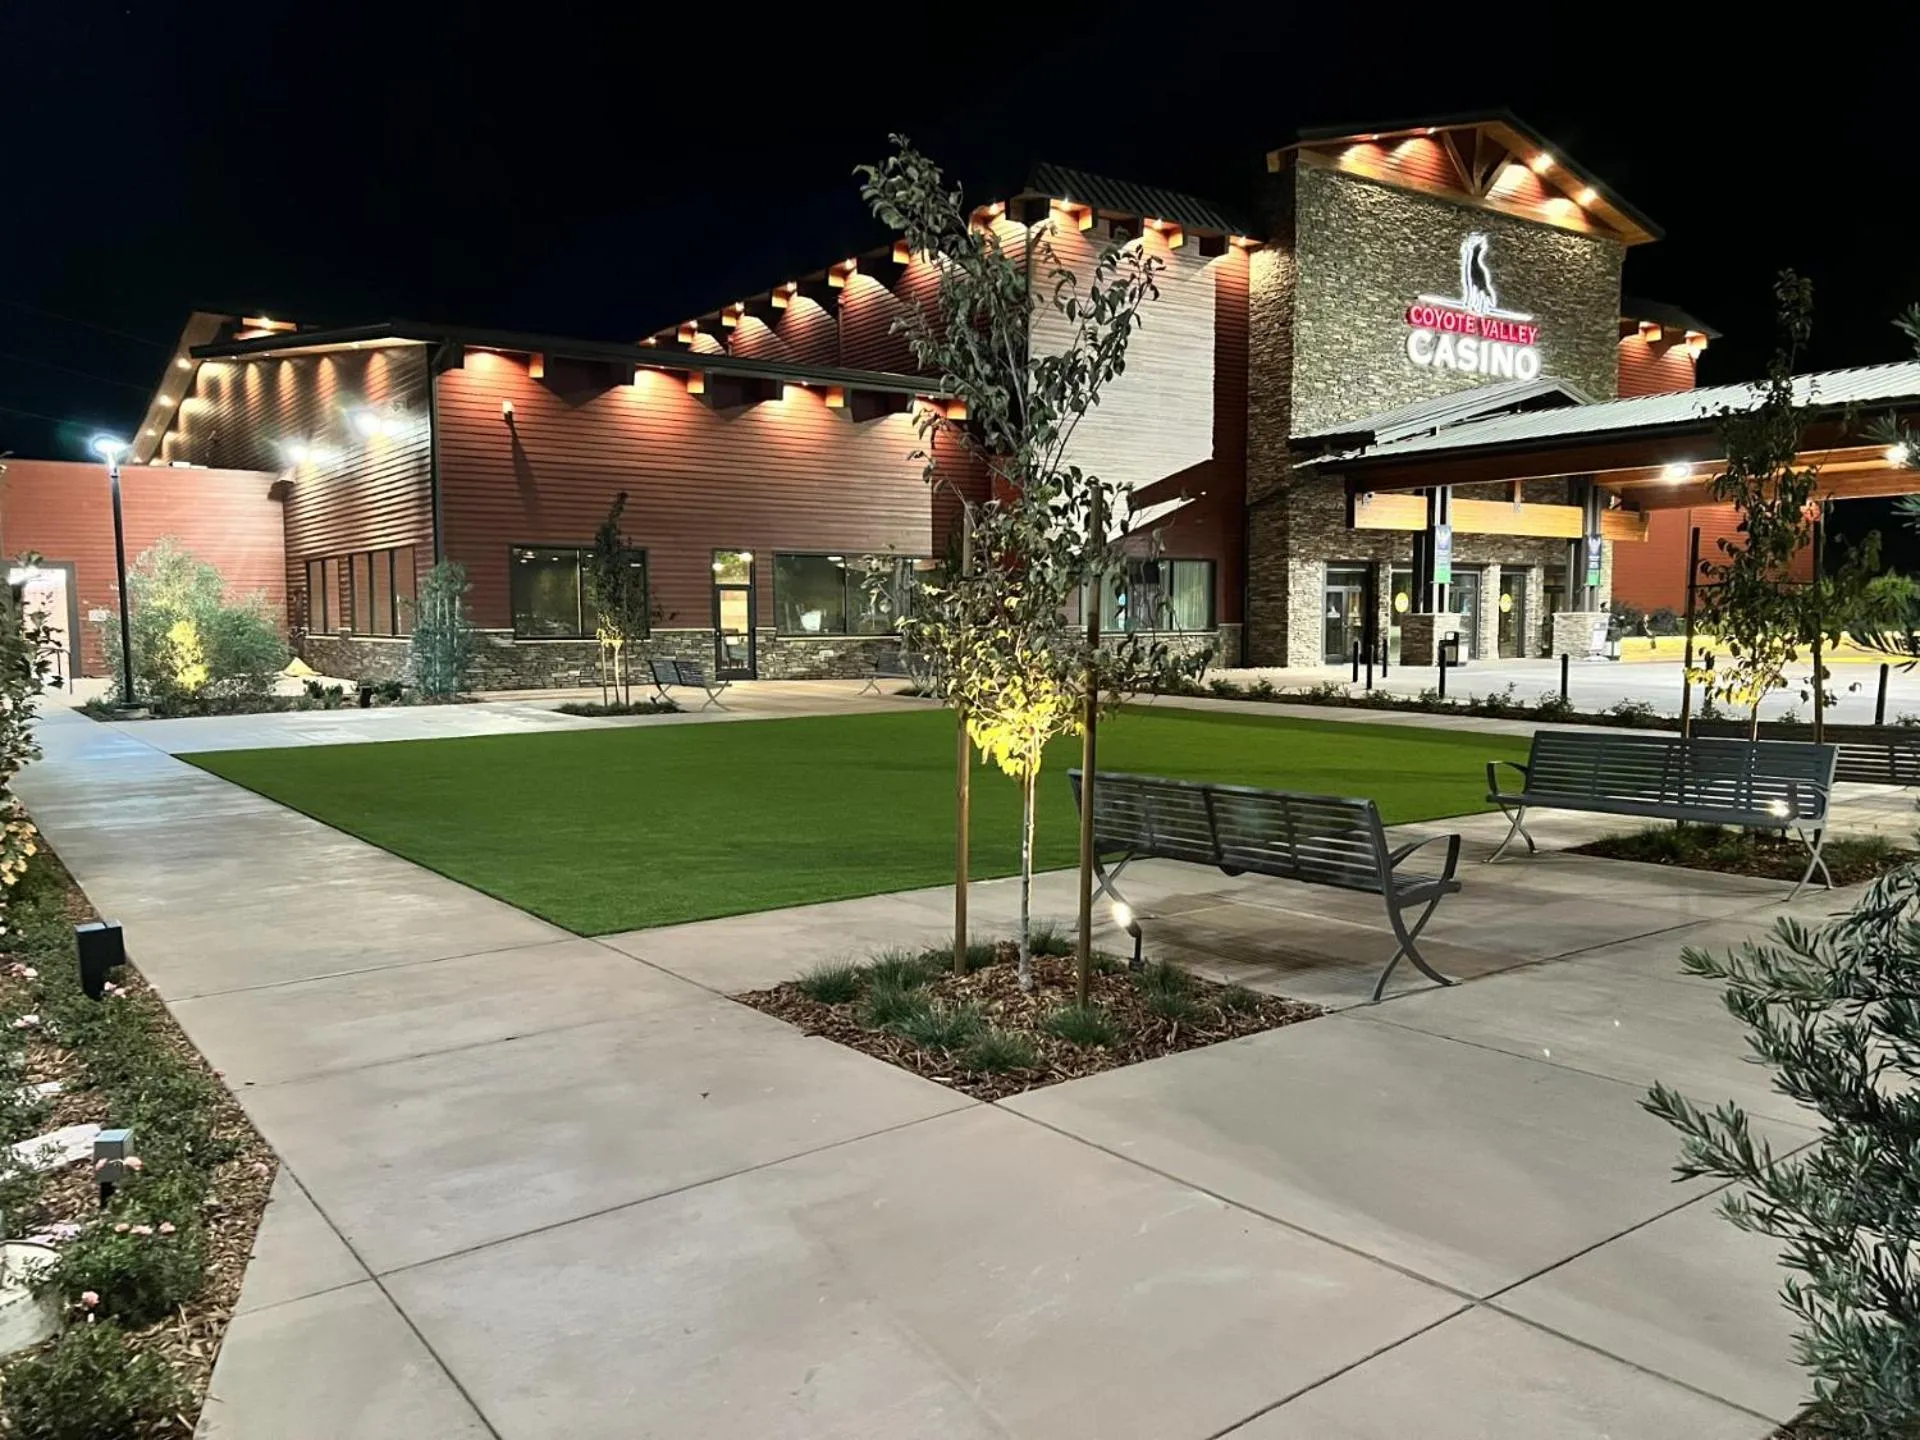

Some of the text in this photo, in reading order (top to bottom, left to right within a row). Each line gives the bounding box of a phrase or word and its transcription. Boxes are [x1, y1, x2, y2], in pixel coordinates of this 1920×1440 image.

[1409, 305, 1538, 344] COYOTE VALLEY
[1407, 329, 1540, 380] CASINO
